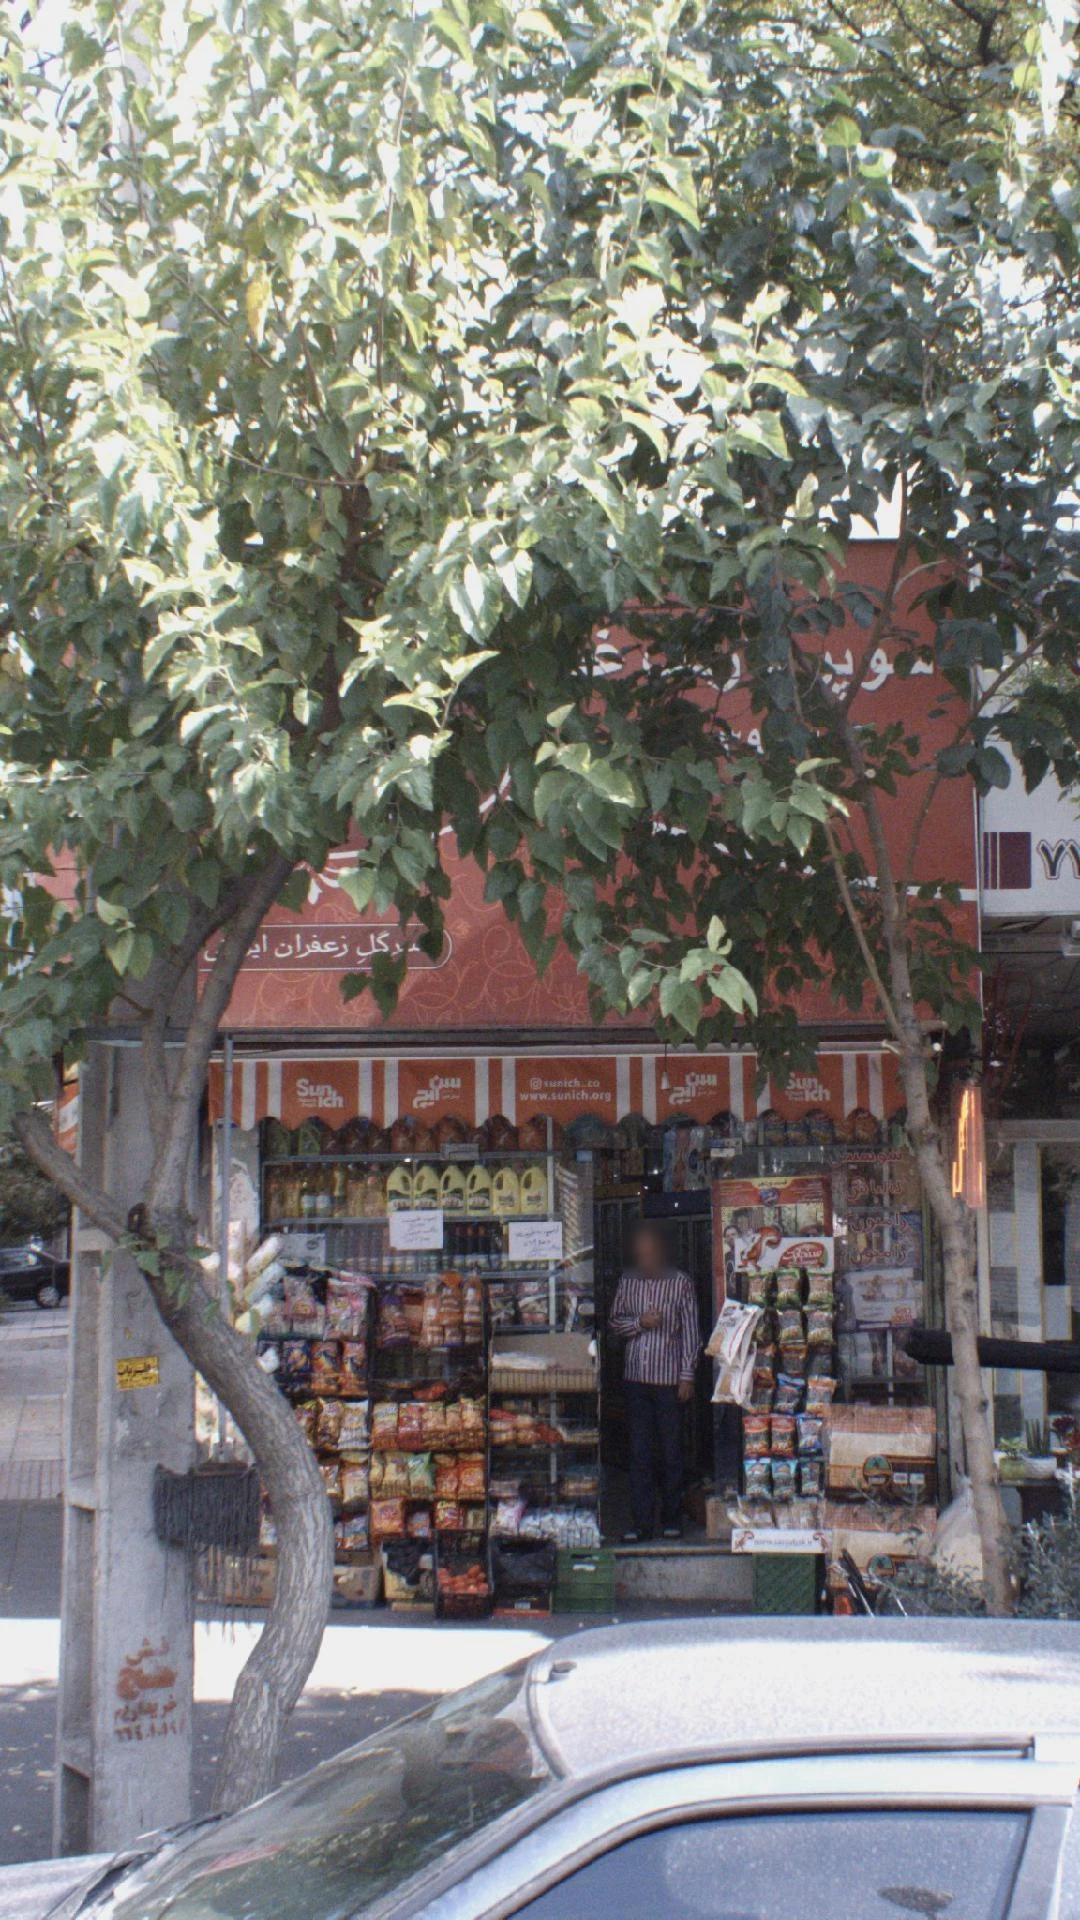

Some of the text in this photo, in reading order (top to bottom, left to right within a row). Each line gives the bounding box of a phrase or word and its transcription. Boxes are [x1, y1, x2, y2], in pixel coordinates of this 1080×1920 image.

[274, 933, 349, 959] زعفران
[296, 1078, 334, 1097] Sun
[519, 1089, 612, 1103] www.sunich.org
